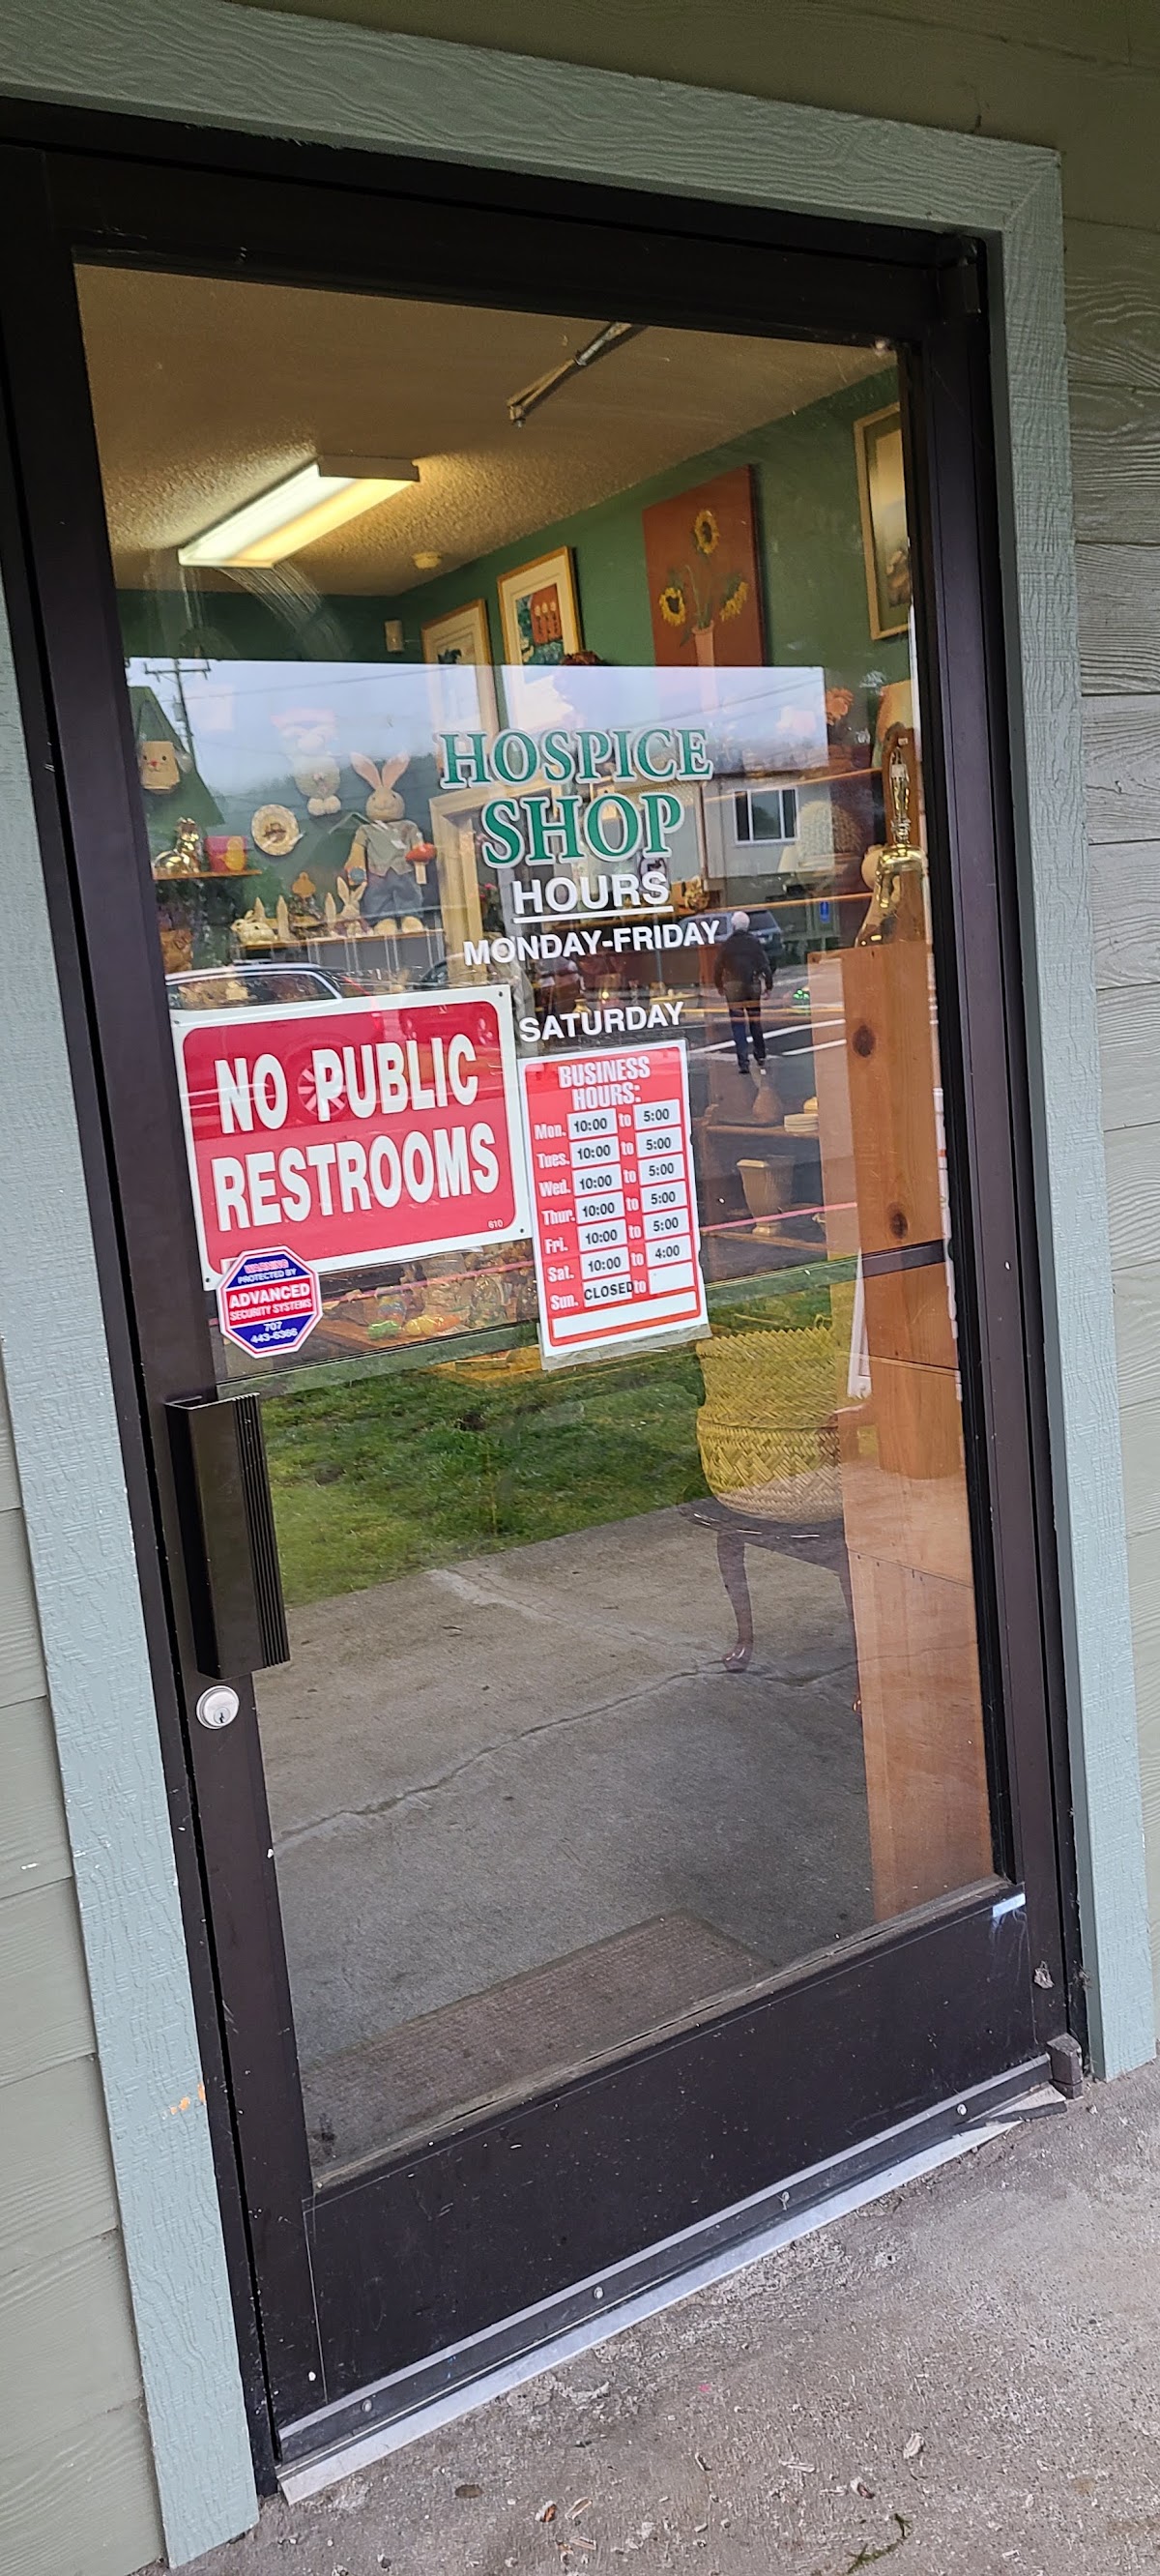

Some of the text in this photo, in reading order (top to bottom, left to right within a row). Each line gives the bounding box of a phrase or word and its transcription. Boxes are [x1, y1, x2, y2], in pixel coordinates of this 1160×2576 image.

[439, 726, 713, 789] HOSPICE
[482, 792, 684, 868] SHOP
[511, 870, 671, 915] HOURS
[463, 920, 720, 966] MONDAY-FRIDAY
[518, 1001, 684, 1043] SATURDAY
[214, 1033, 478, 1134] NO PUBLIC
[557, 1055, 651, 1089] BUSINESS
[571, 1081, 642, 1111] HOURS:
[534, 1108, 670, 1140] Mon. 10:00 to 5:00
[536, 1137, 672, 1168] Tues. 10:00 to 5:00
[211, 1122, 500, 1232] RESTROOMS
[538, 1162, 675, 1197] Wed. 10:00 to 5:00
[487, 1219, 504, 1229] 610
[541, 1190, 676, 1226] Thur. 10:00 to 5:00
[544, 1216, 679, 1254] Fri. 10:00 to 5:00
[237, 1268, 297, 1284] PROTECTED BY
[244, 1259, 289, 1274] WARNING
[547, 1244, 681, 1283] Sat. 10:00 to 4:00
[228, 1282, 310, 1309] ADVANCED
[229, 1299, 312, 1322] SECURITY SYSTEMS
[550, 1279, 647, 1311] Sun. CLOSED to
[263, 1321, 282, 1332] 707
